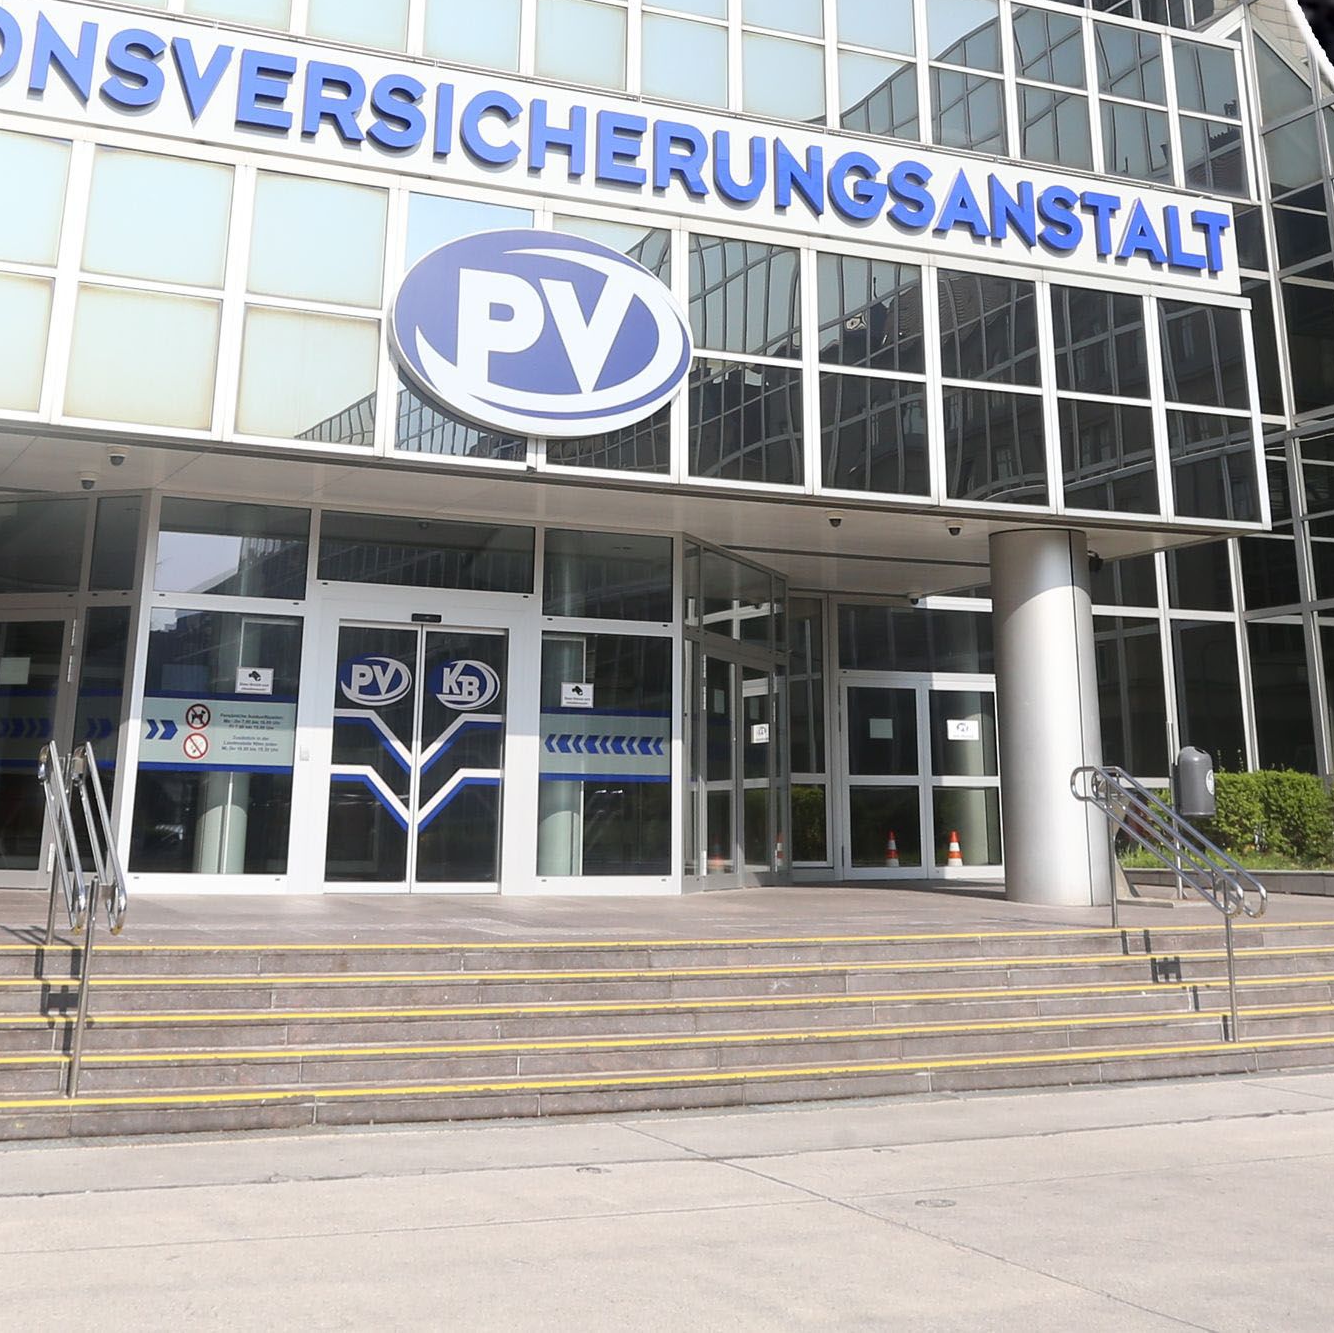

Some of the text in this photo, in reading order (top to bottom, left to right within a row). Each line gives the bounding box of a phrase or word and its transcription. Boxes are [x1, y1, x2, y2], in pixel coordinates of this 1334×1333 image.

[455, 267, 636, 394] PV
[350, 663, 398, 696] PV
[442, 661, 480, 702] KB
